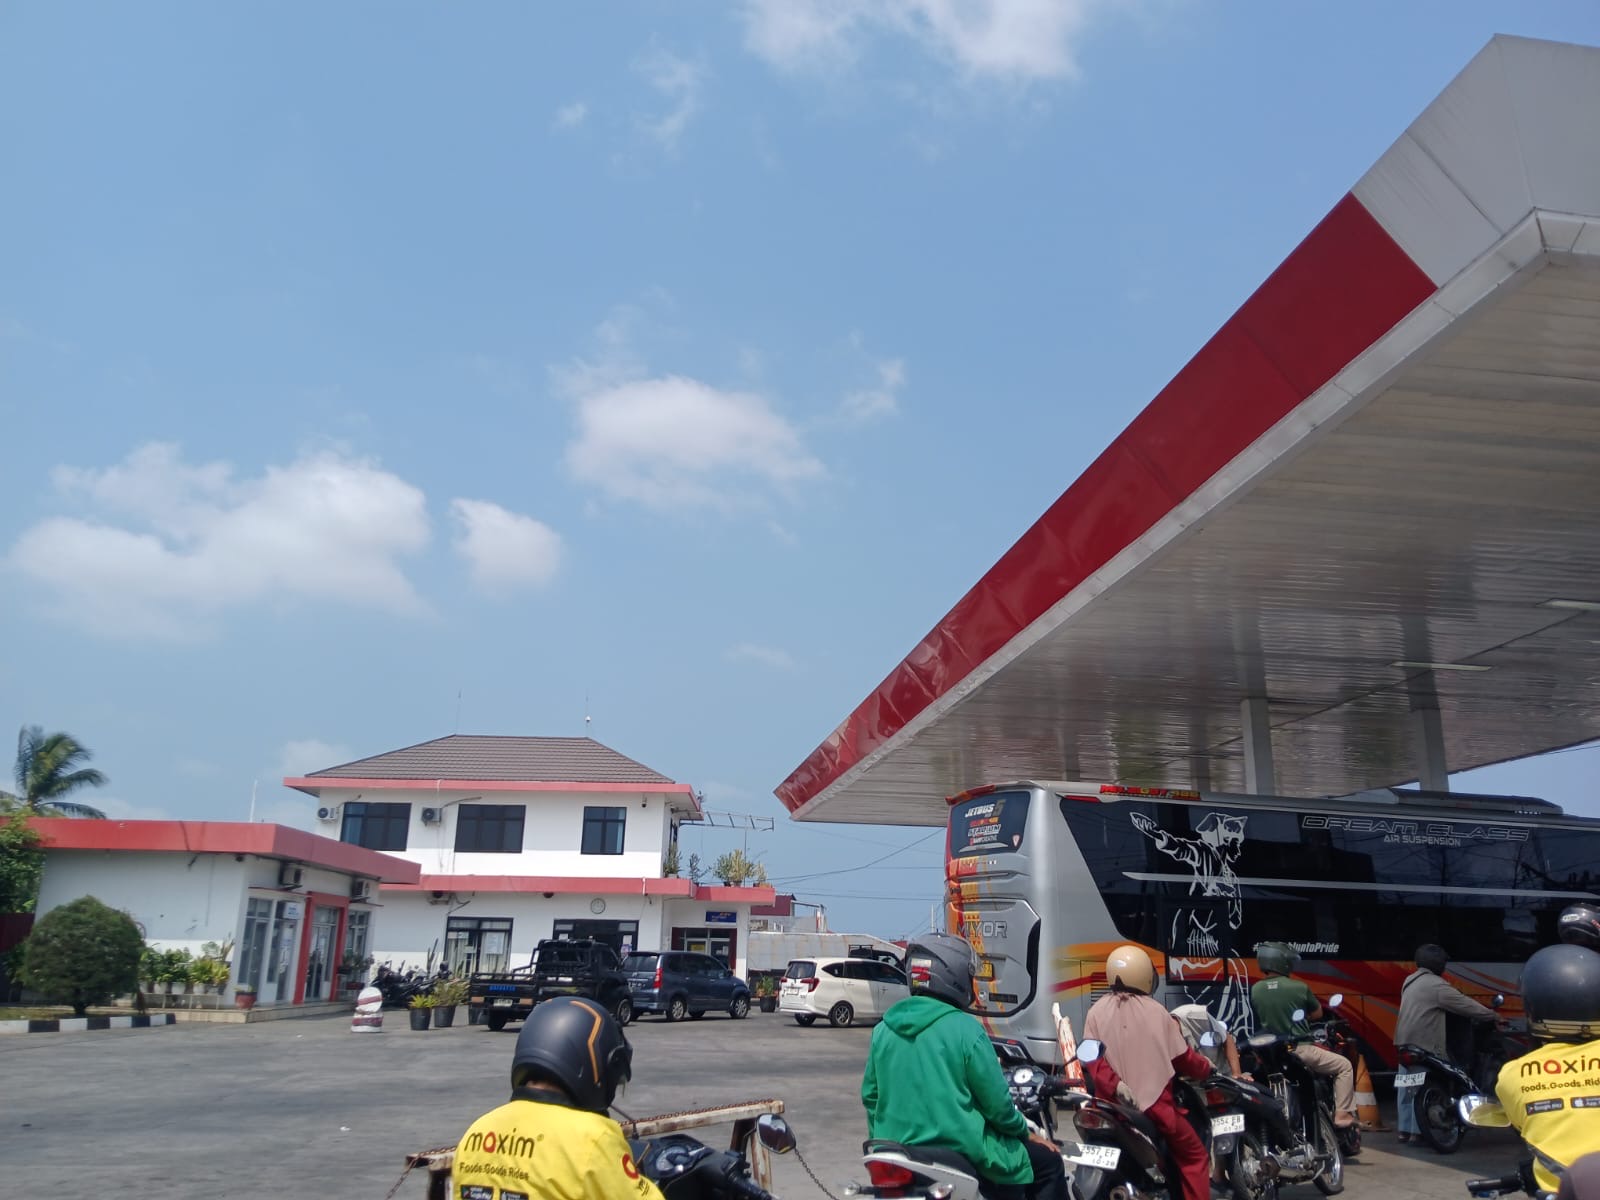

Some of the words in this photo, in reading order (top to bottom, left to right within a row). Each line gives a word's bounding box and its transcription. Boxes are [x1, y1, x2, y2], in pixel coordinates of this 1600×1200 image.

[965, 804, 995, 817] JETBUS
[1302, 815, 1419, 835] DREAM
[1426, 823, 1530, 842] CLASS
[1383, 834, 1400, 843] AIR
[1402, 834, 1461, 846] SUSPENSION
[464, 1128, 535, 1158] maxim
